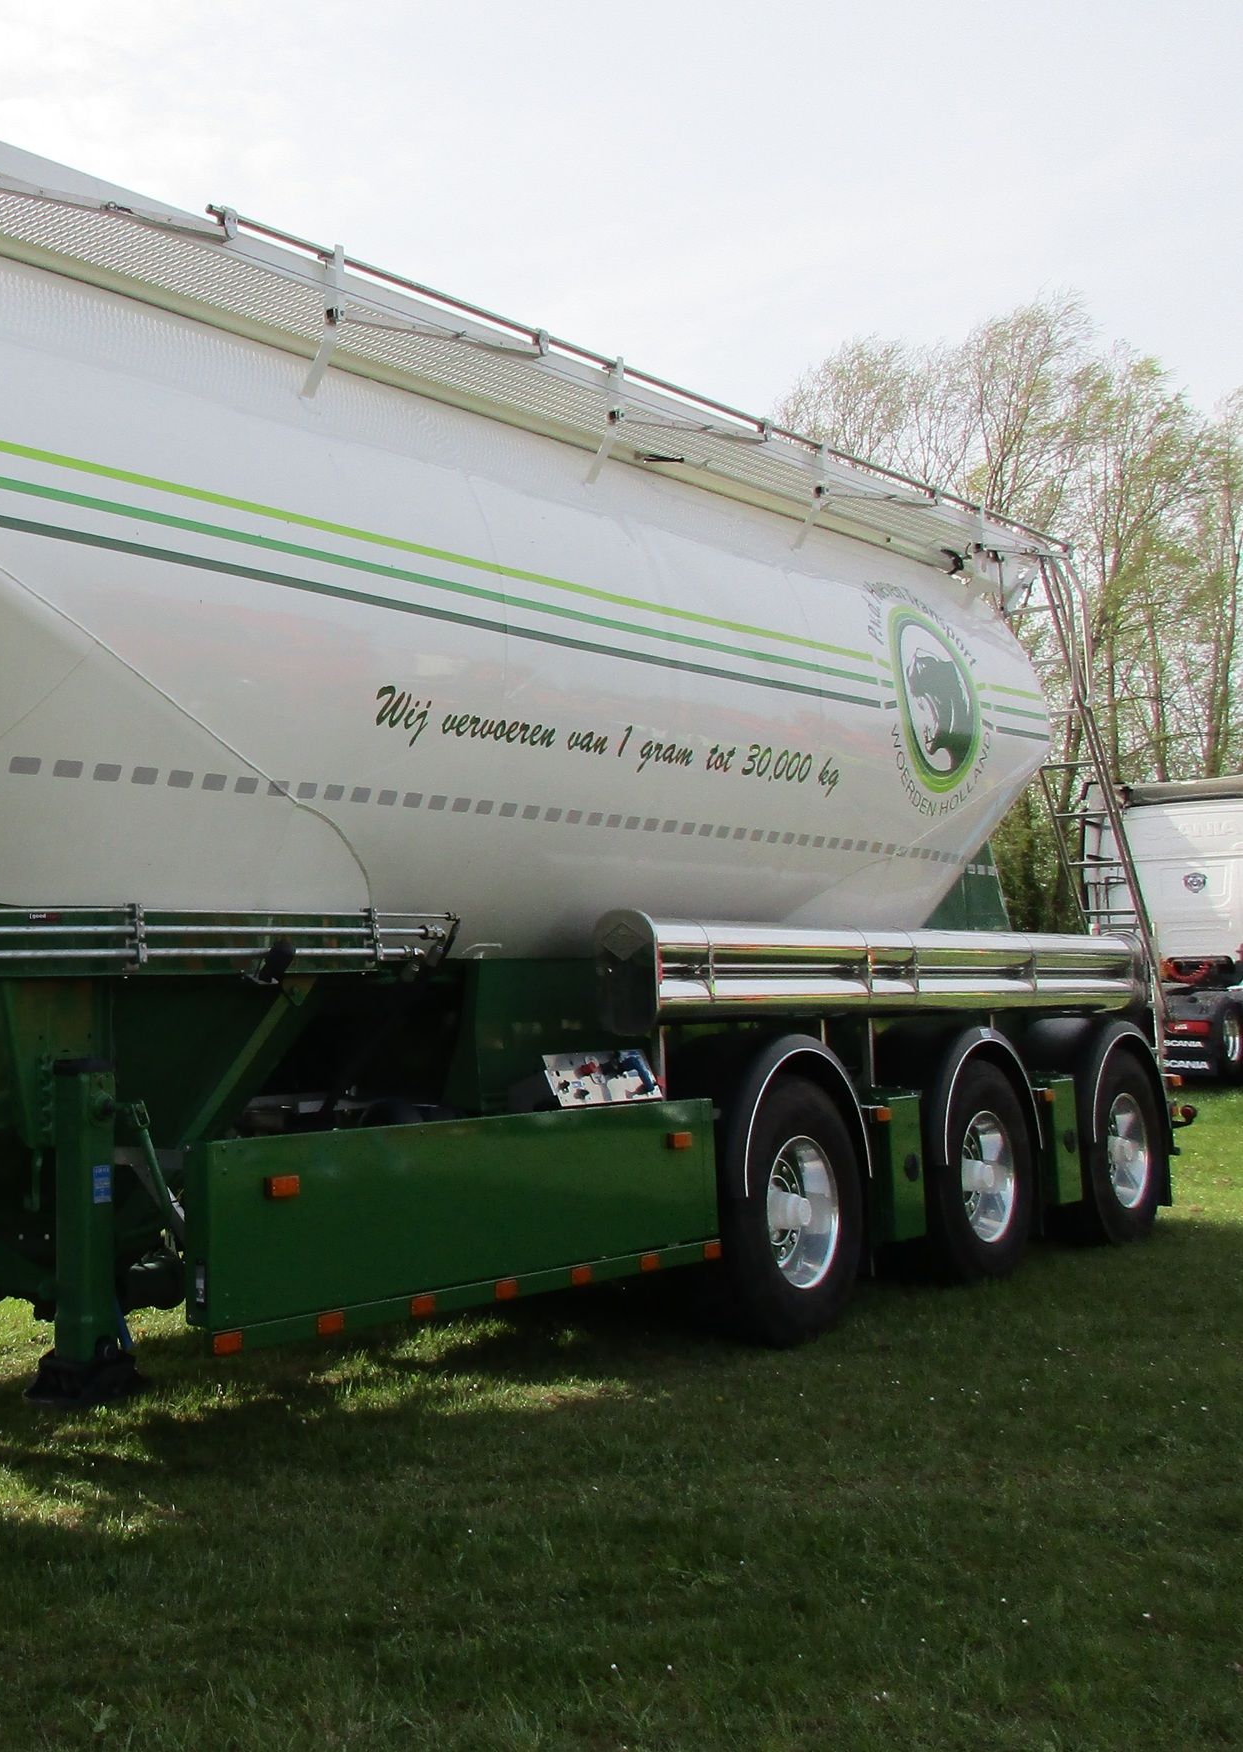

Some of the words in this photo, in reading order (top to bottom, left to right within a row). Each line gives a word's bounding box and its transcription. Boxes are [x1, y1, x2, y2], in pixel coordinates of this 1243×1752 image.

[376, 685, 432, 748] Wij
[441, 713, 557, 749] vervoeren
[567, 728, 609, 755] van
[617, 724, 633, 758] 1
[636, 739, 694, 774] gram
[706, 743, 737, 774] tot
[741, 743, 813, 783] 30,000
[818, 756, 841, 798] kg
[891, 723, 937, 816] WOERDEN
[939, 731, 990, 817] HOLLAND
[1162, 1059, 1210, 1070] SCANIA
[1163, 1039, 1204, 1048] SCANIA
